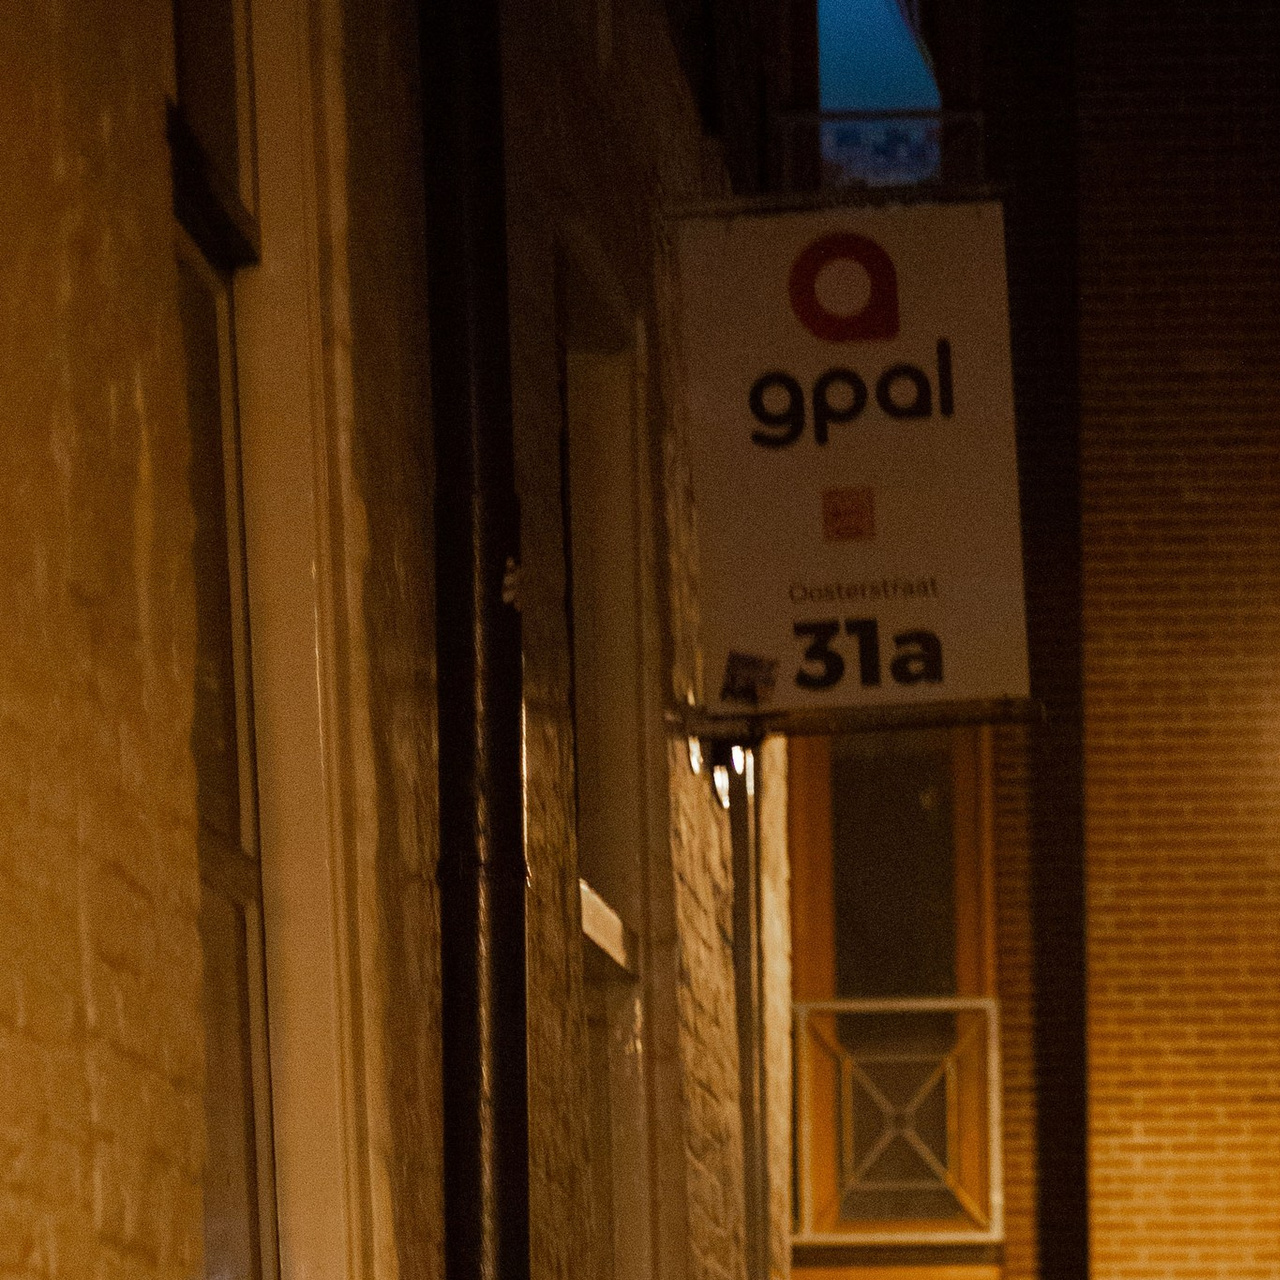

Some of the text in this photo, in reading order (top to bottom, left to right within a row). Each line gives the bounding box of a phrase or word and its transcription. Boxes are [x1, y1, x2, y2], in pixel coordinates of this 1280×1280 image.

[747, 337, 955, 448] gpal
[788, 576, 940, 603] Oosterstraat
[792, 616, 944, 692] 31a
